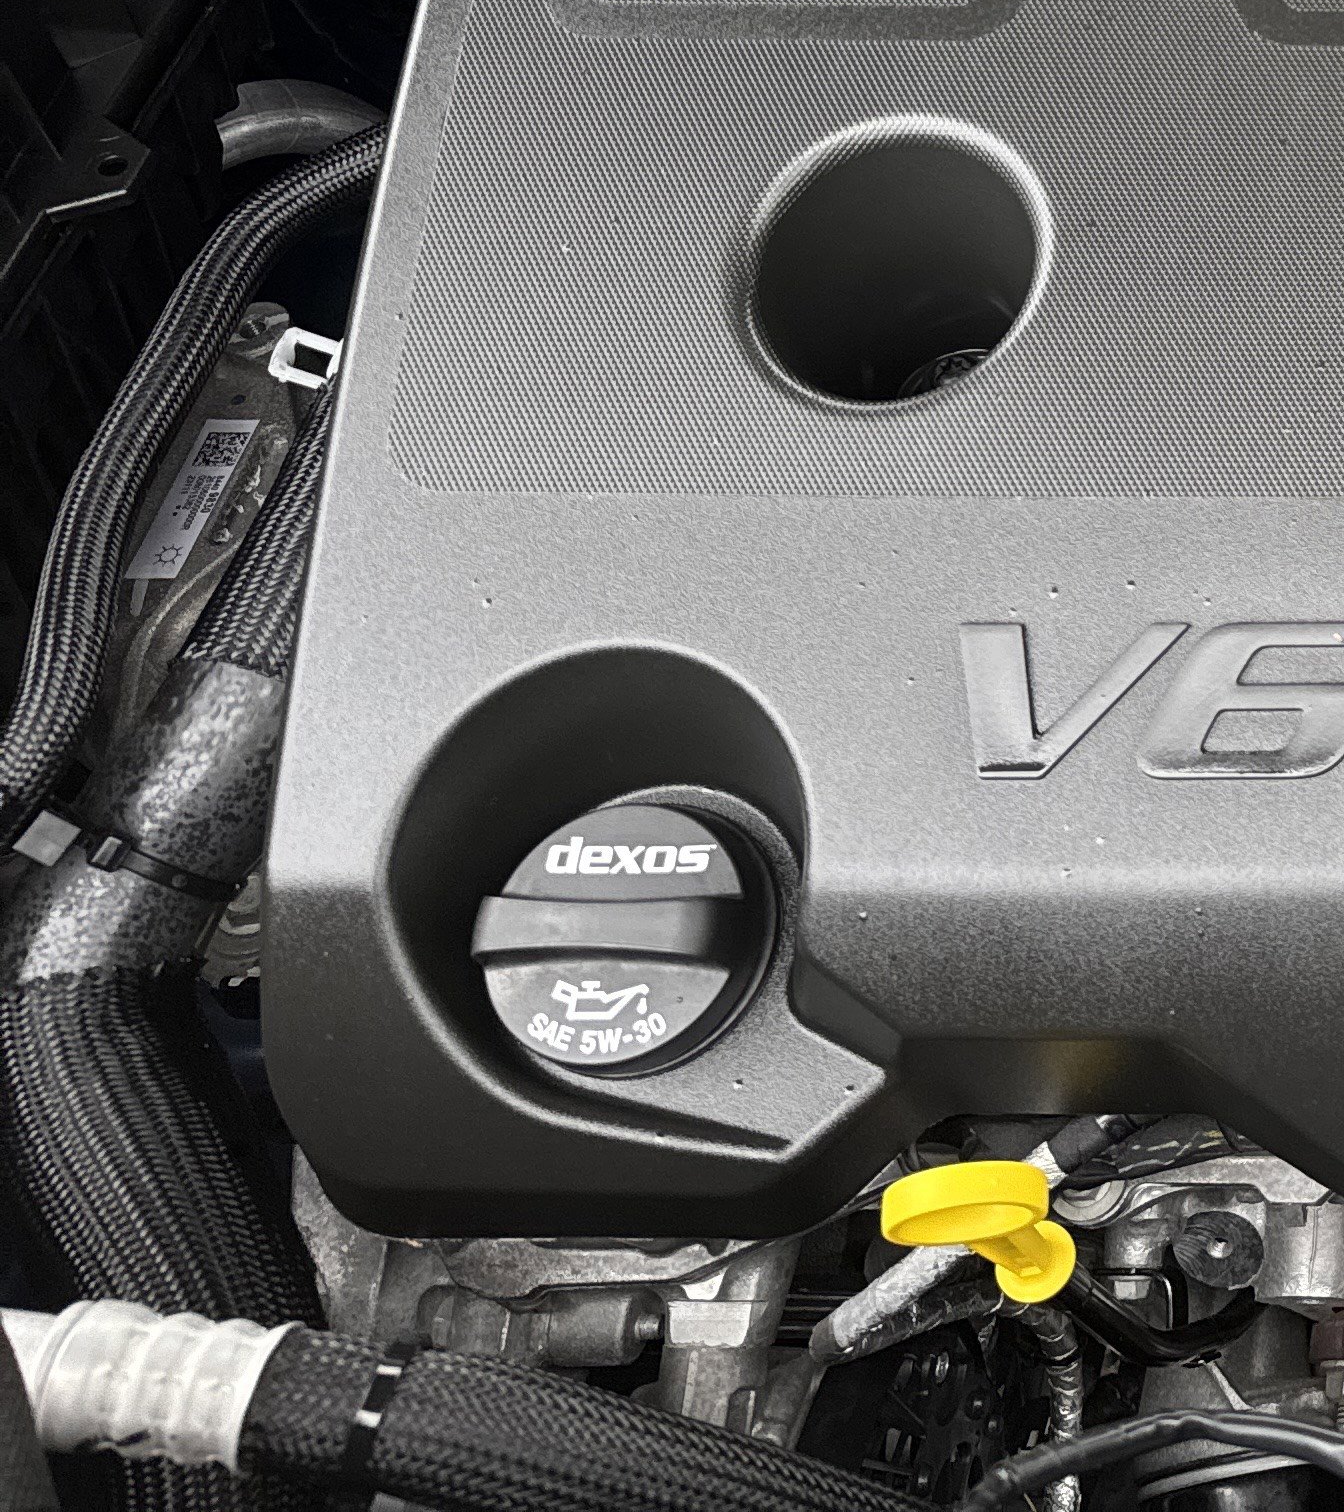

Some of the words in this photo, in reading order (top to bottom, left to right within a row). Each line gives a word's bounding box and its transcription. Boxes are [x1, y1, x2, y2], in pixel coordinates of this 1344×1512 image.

[545, 837, 718, 875] dexos
[527, 1013, 576, 1051] SAE
[580, 1013, 667, 1055] 5W-30
